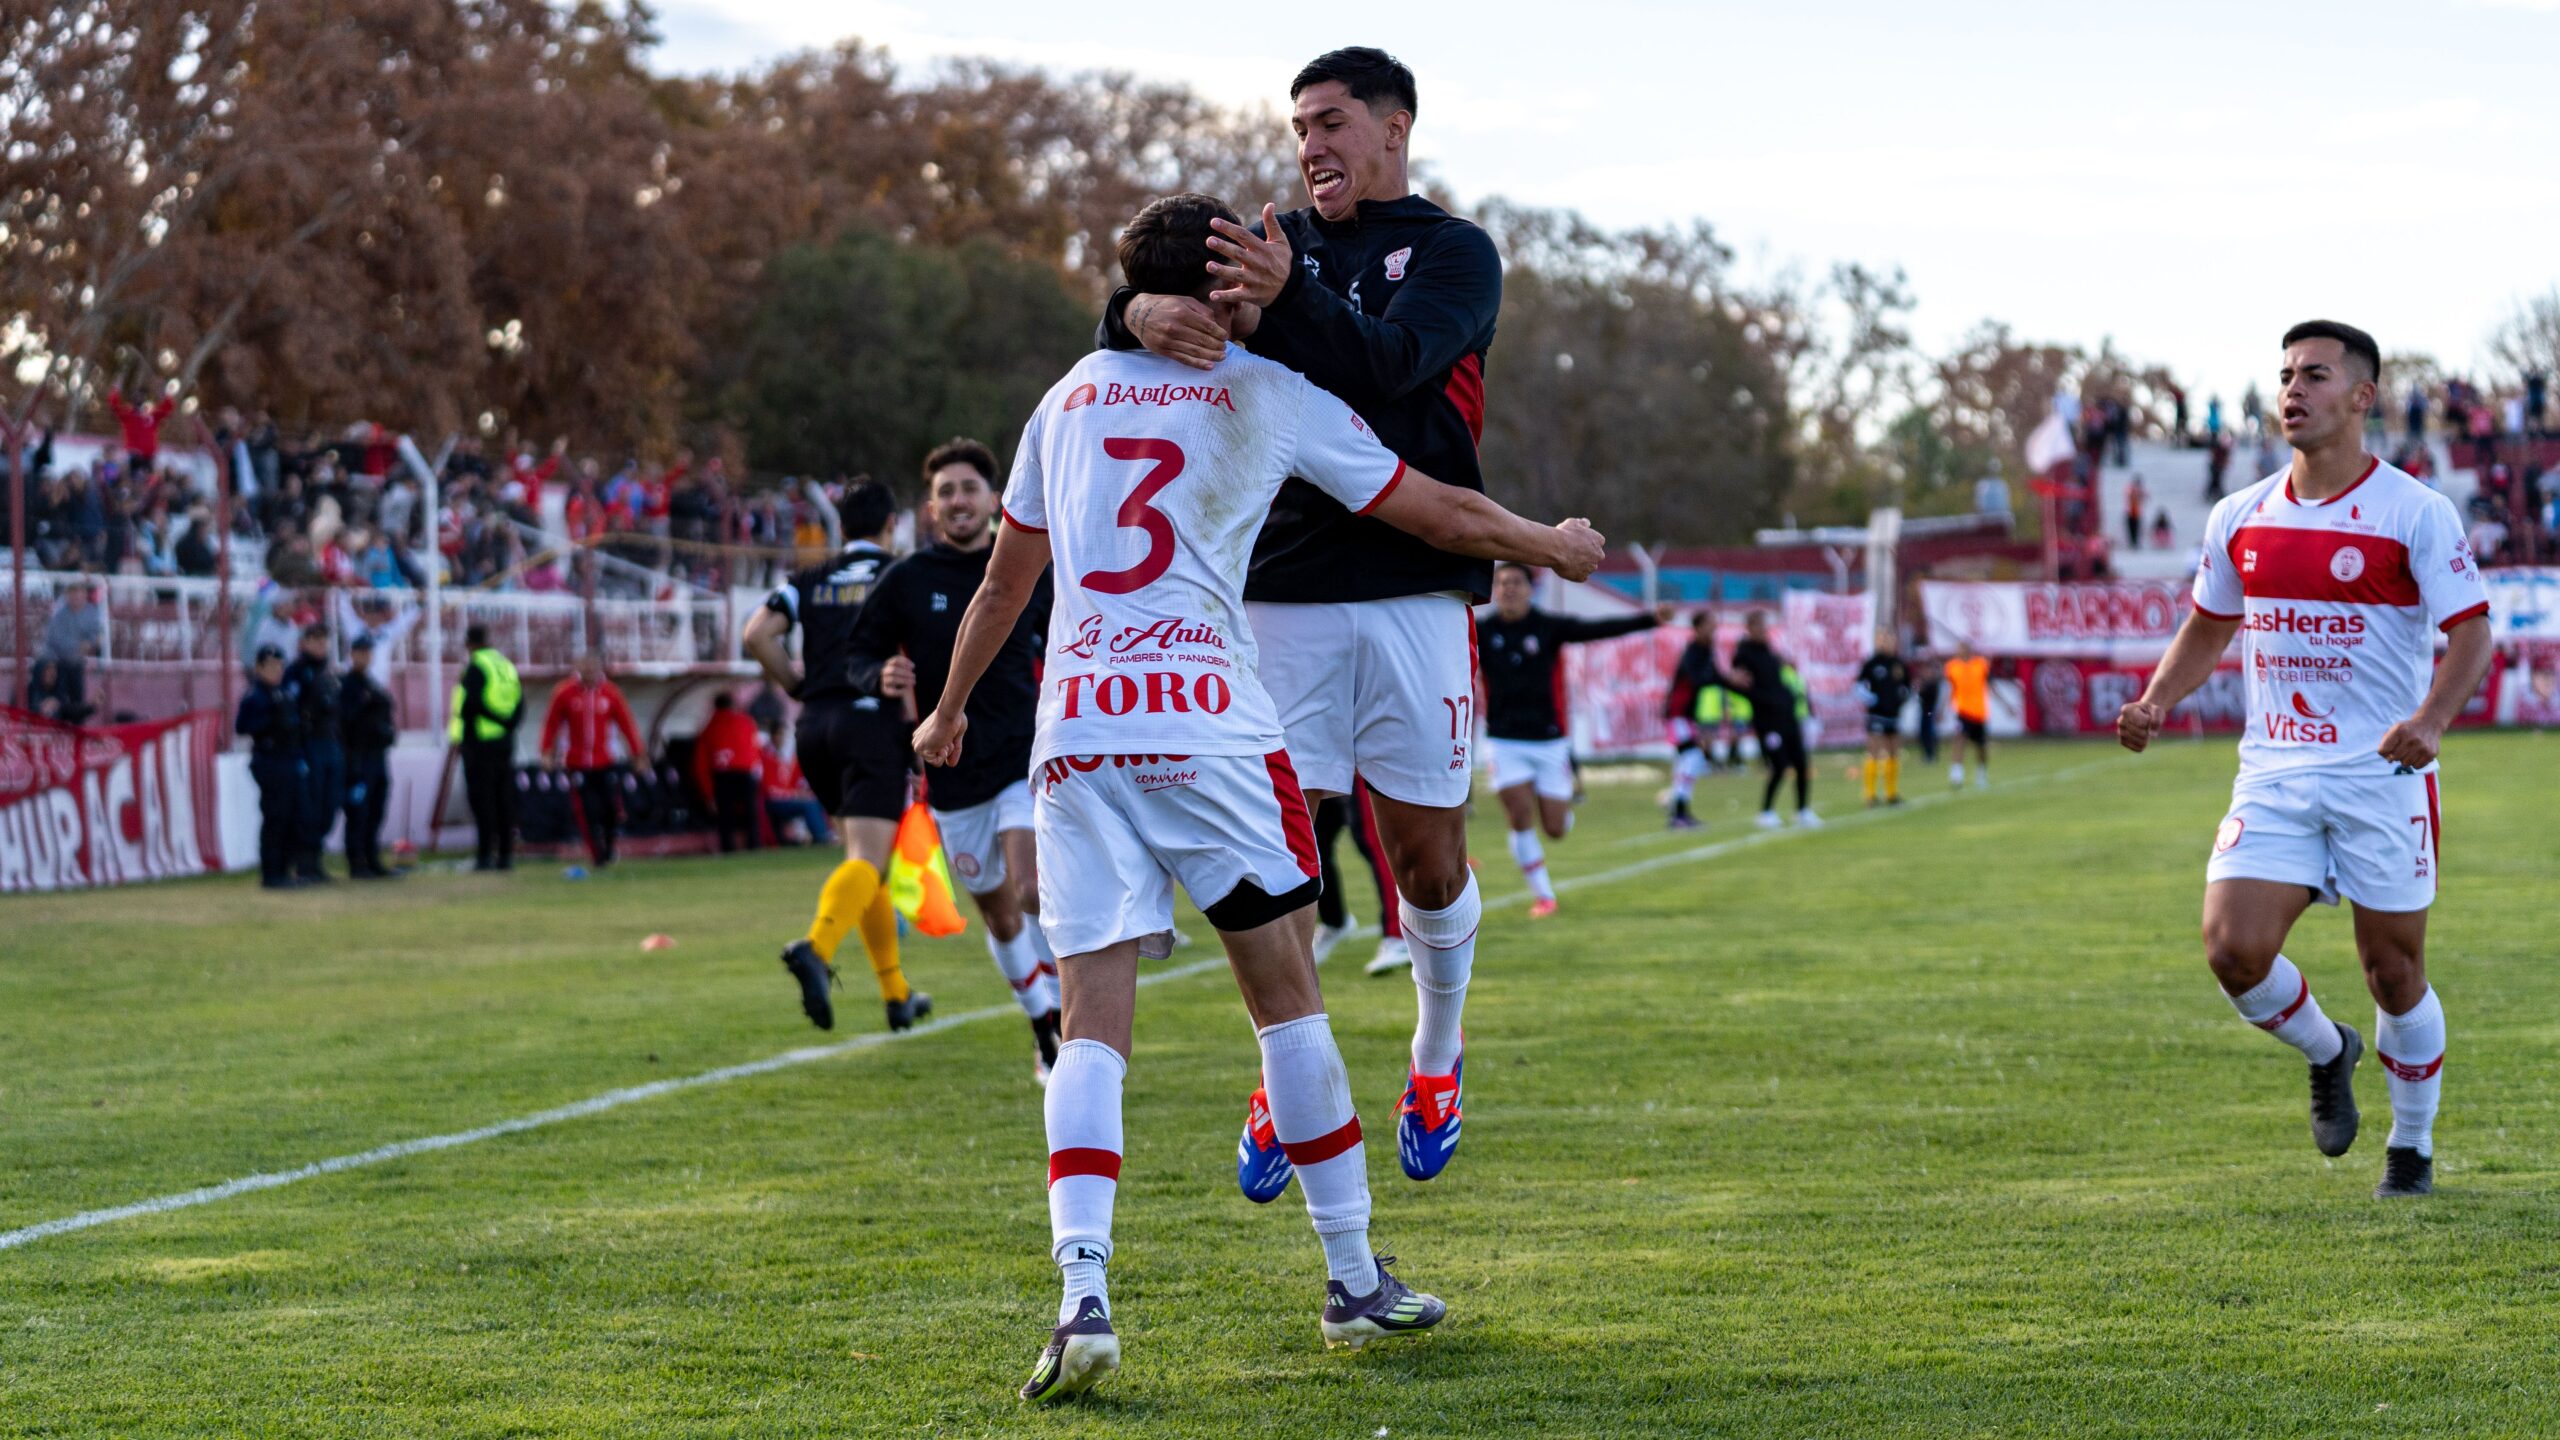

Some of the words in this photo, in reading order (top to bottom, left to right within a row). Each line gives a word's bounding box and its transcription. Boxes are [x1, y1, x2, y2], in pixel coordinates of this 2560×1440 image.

[1080, 437, 1185, 595] 3
[1057, 614, 1104, 659] La
[1109, 616, 1227, 653] Anita
[2309, 635, 2323, 645] tu
[2326, 634, 2365, 648] hogar
[1109, 653, 1163, 665] FIAMBRES
[1167, 653, 1175, 662] Y
[2268, 655, 2352, 669] MENDOZA
[2271, 670, 2353, 682] GOBIERNO
[1057, 672, 1231, 721] TORO
[1443, 695, 1470, 740] 17
[2265, 712, 2337, 743] Vitsa
[1135, 768, 1197, 785] conviene
[2410, 815, 2427, 851] 7
